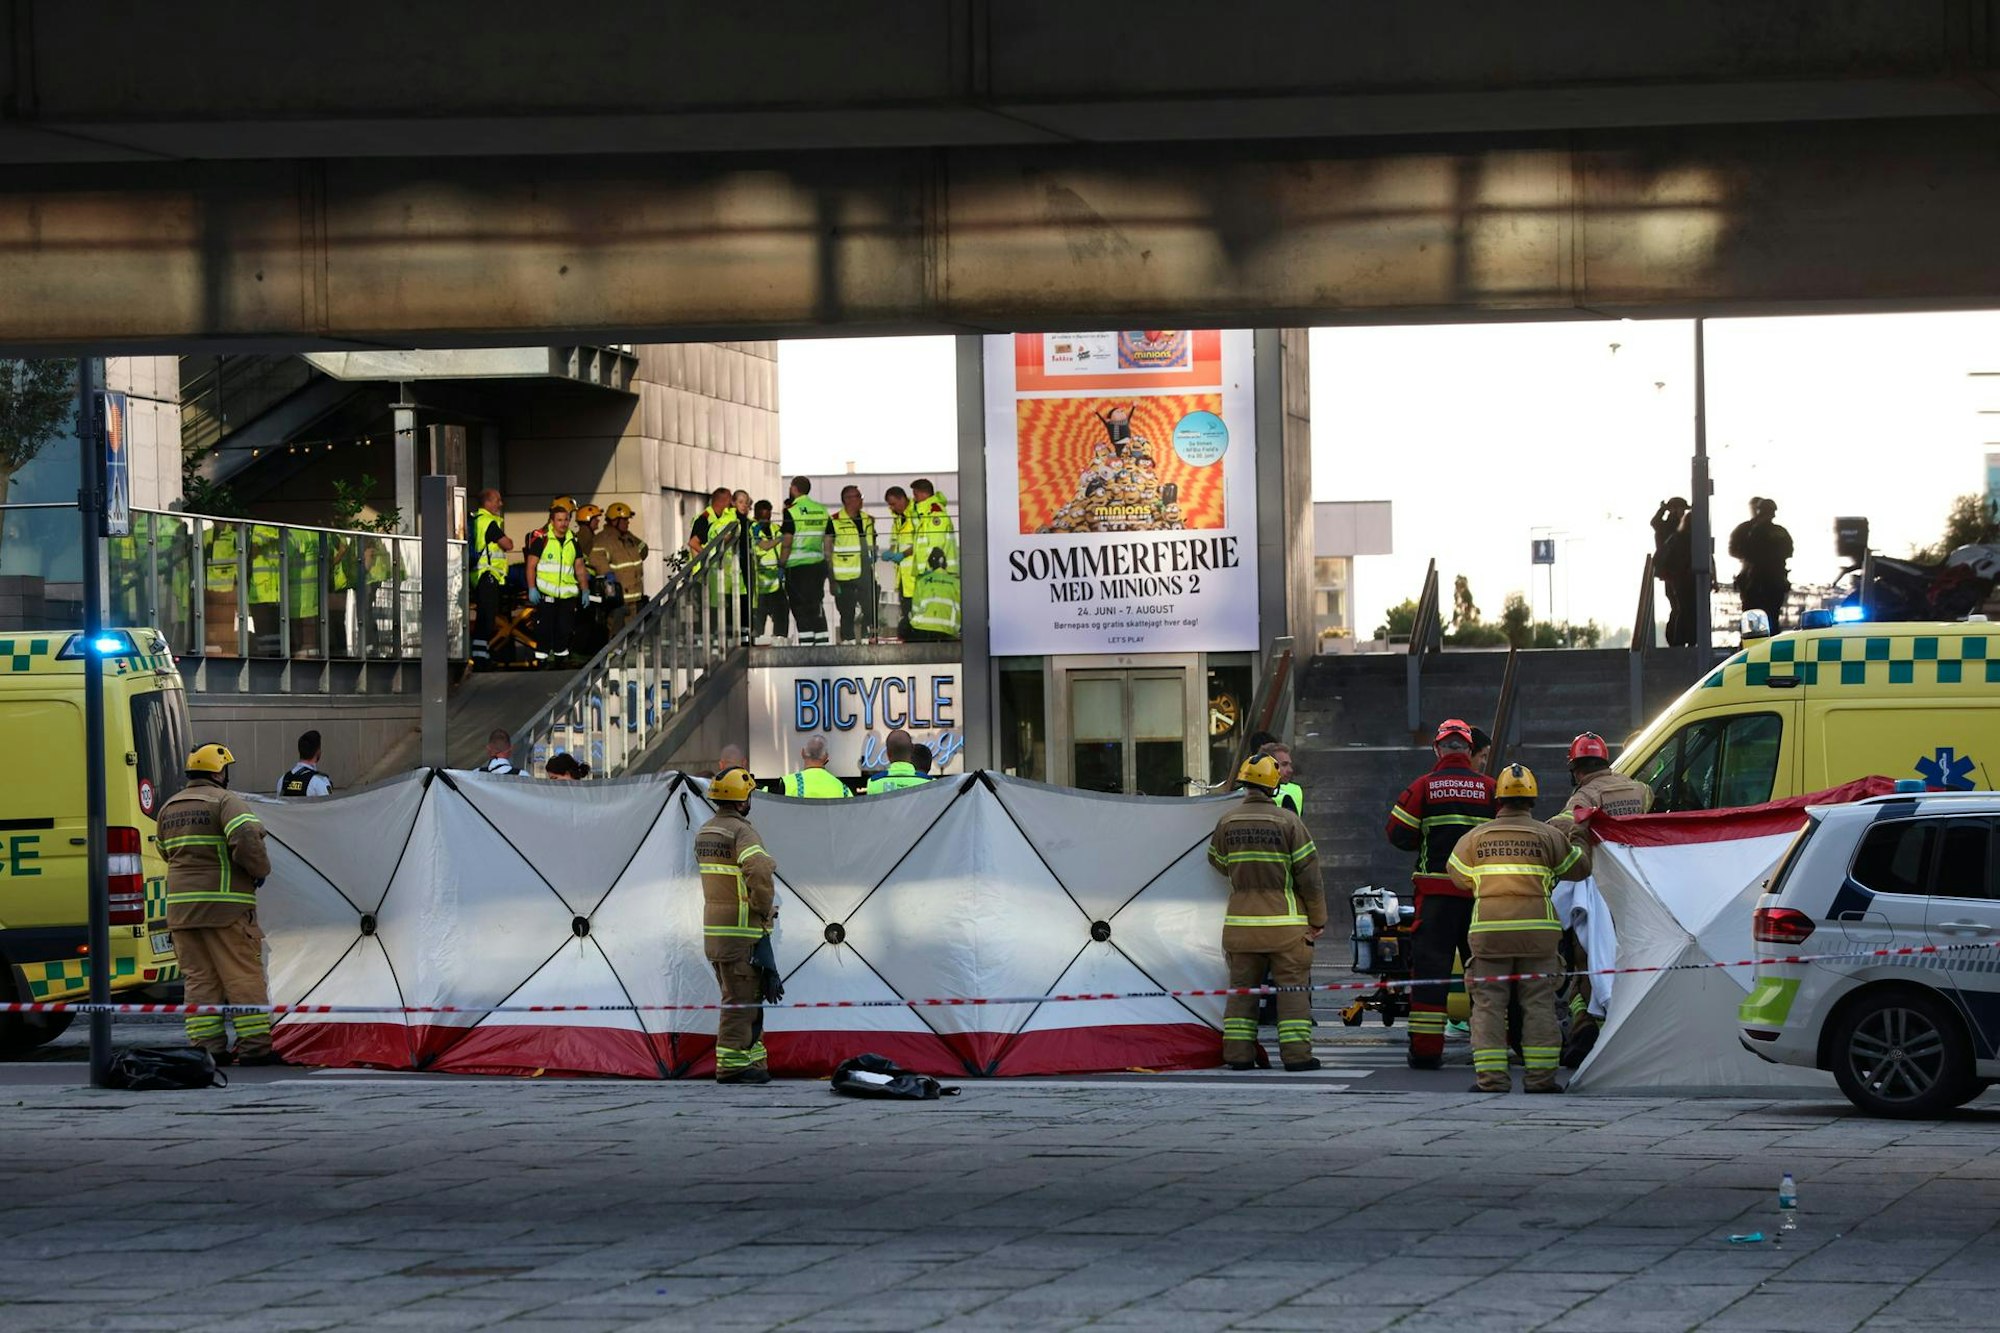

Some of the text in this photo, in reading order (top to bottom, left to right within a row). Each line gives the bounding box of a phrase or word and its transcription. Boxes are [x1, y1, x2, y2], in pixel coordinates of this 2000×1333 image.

[1094, 505, 1151, 516] minions
[1009, 536, 1239, 581] SOMMERFERIE
[1050, 574, 1201, 603] MED MINIONS 2
[1078, 607, 1092, 616] 24.
[1094, 607, 1116, 616] JUNI
[1136, 605, 1174, 614] AUGUST
[1054, 618, 1199, 630] Børnepas og gratis skattejagt hver dag!
[795, 675, 954, 732] BICYCLE
[1429, 780, 1474, 789] BEREDSKAB
[1430, 789, 1486, 799] HOLDLEDER
[0, 835, 41, 876] E
[1477, 848, 1541, 859] BEREDSKAB
